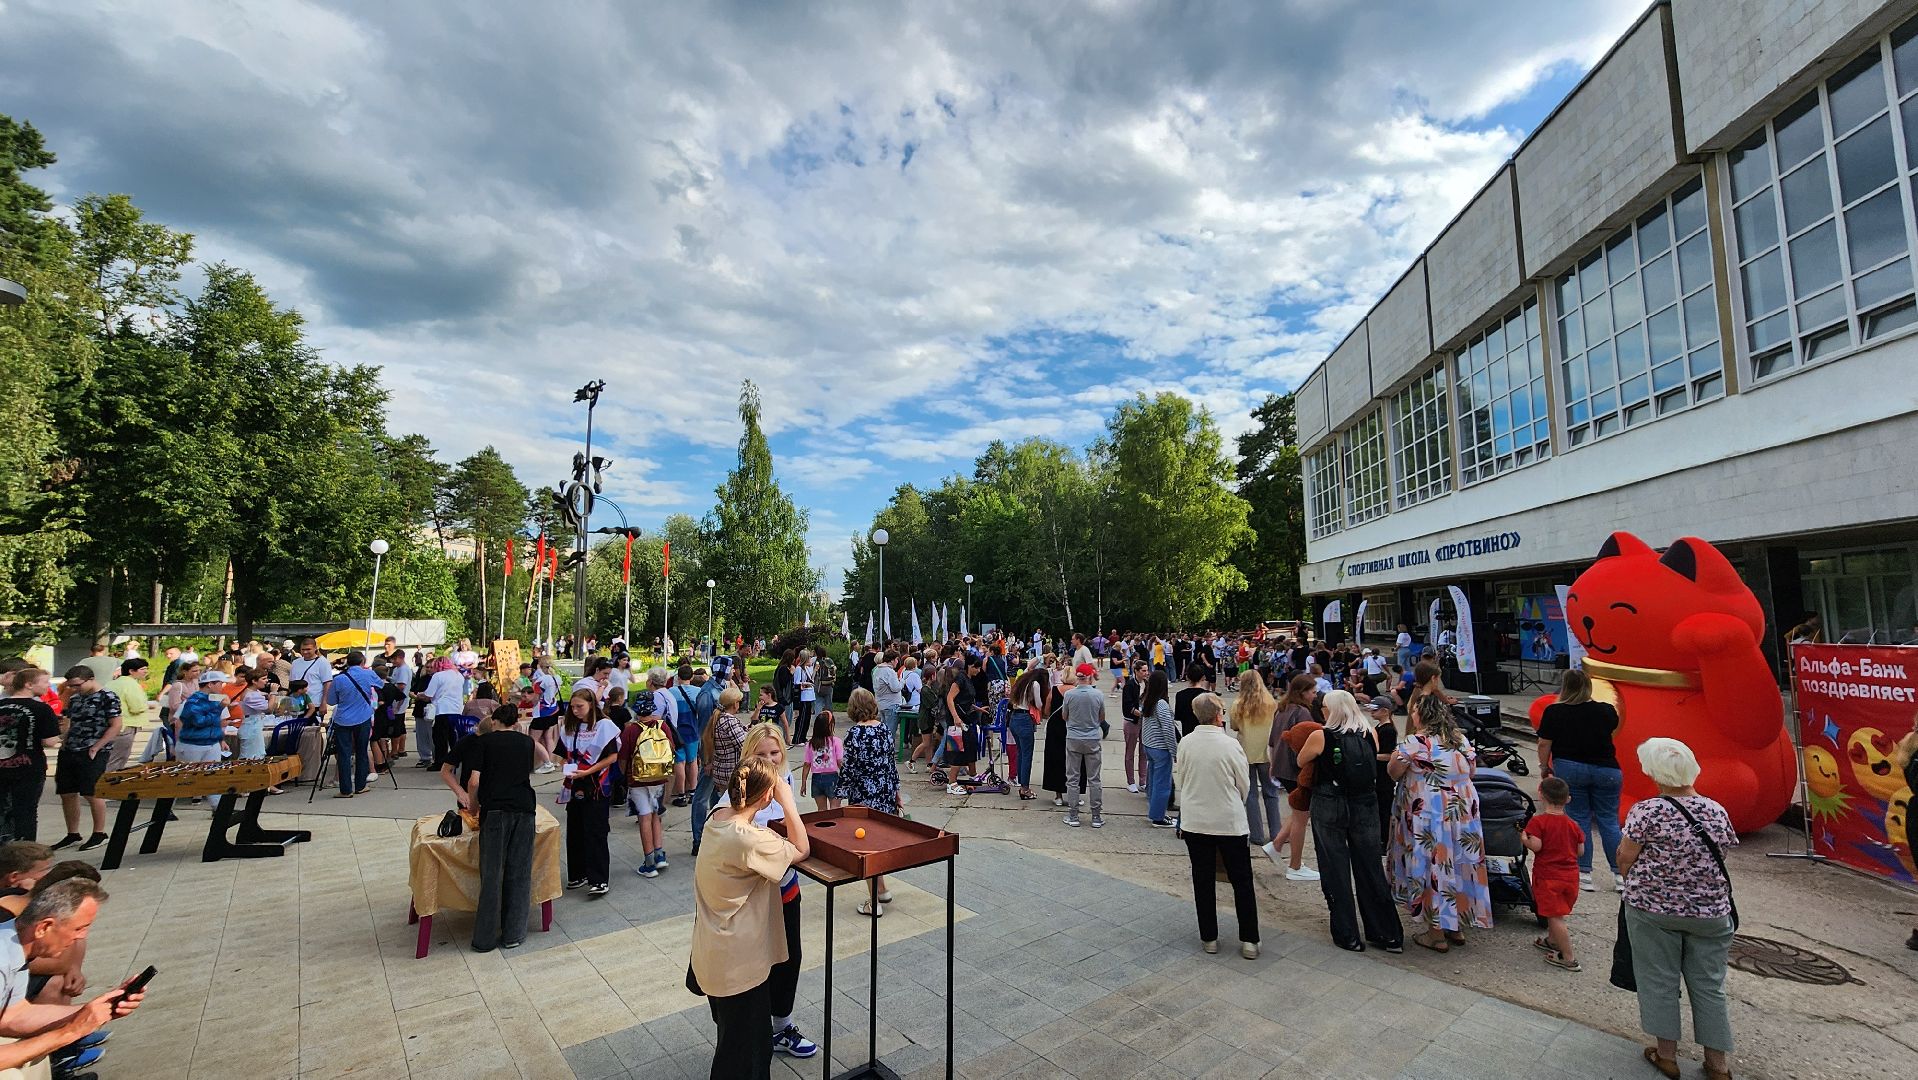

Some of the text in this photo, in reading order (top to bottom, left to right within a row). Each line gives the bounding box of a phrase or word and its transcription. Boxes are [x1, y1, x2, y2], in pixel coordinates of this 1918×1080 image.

[1347, 531, 1521, 576] СПОРТИВНАЯ ШКОЛА «ПРОТВИНО»
[1800, 656, 1907, 679] Альфа-Банк
[1801, 679, 1915, 702] поздравляет
